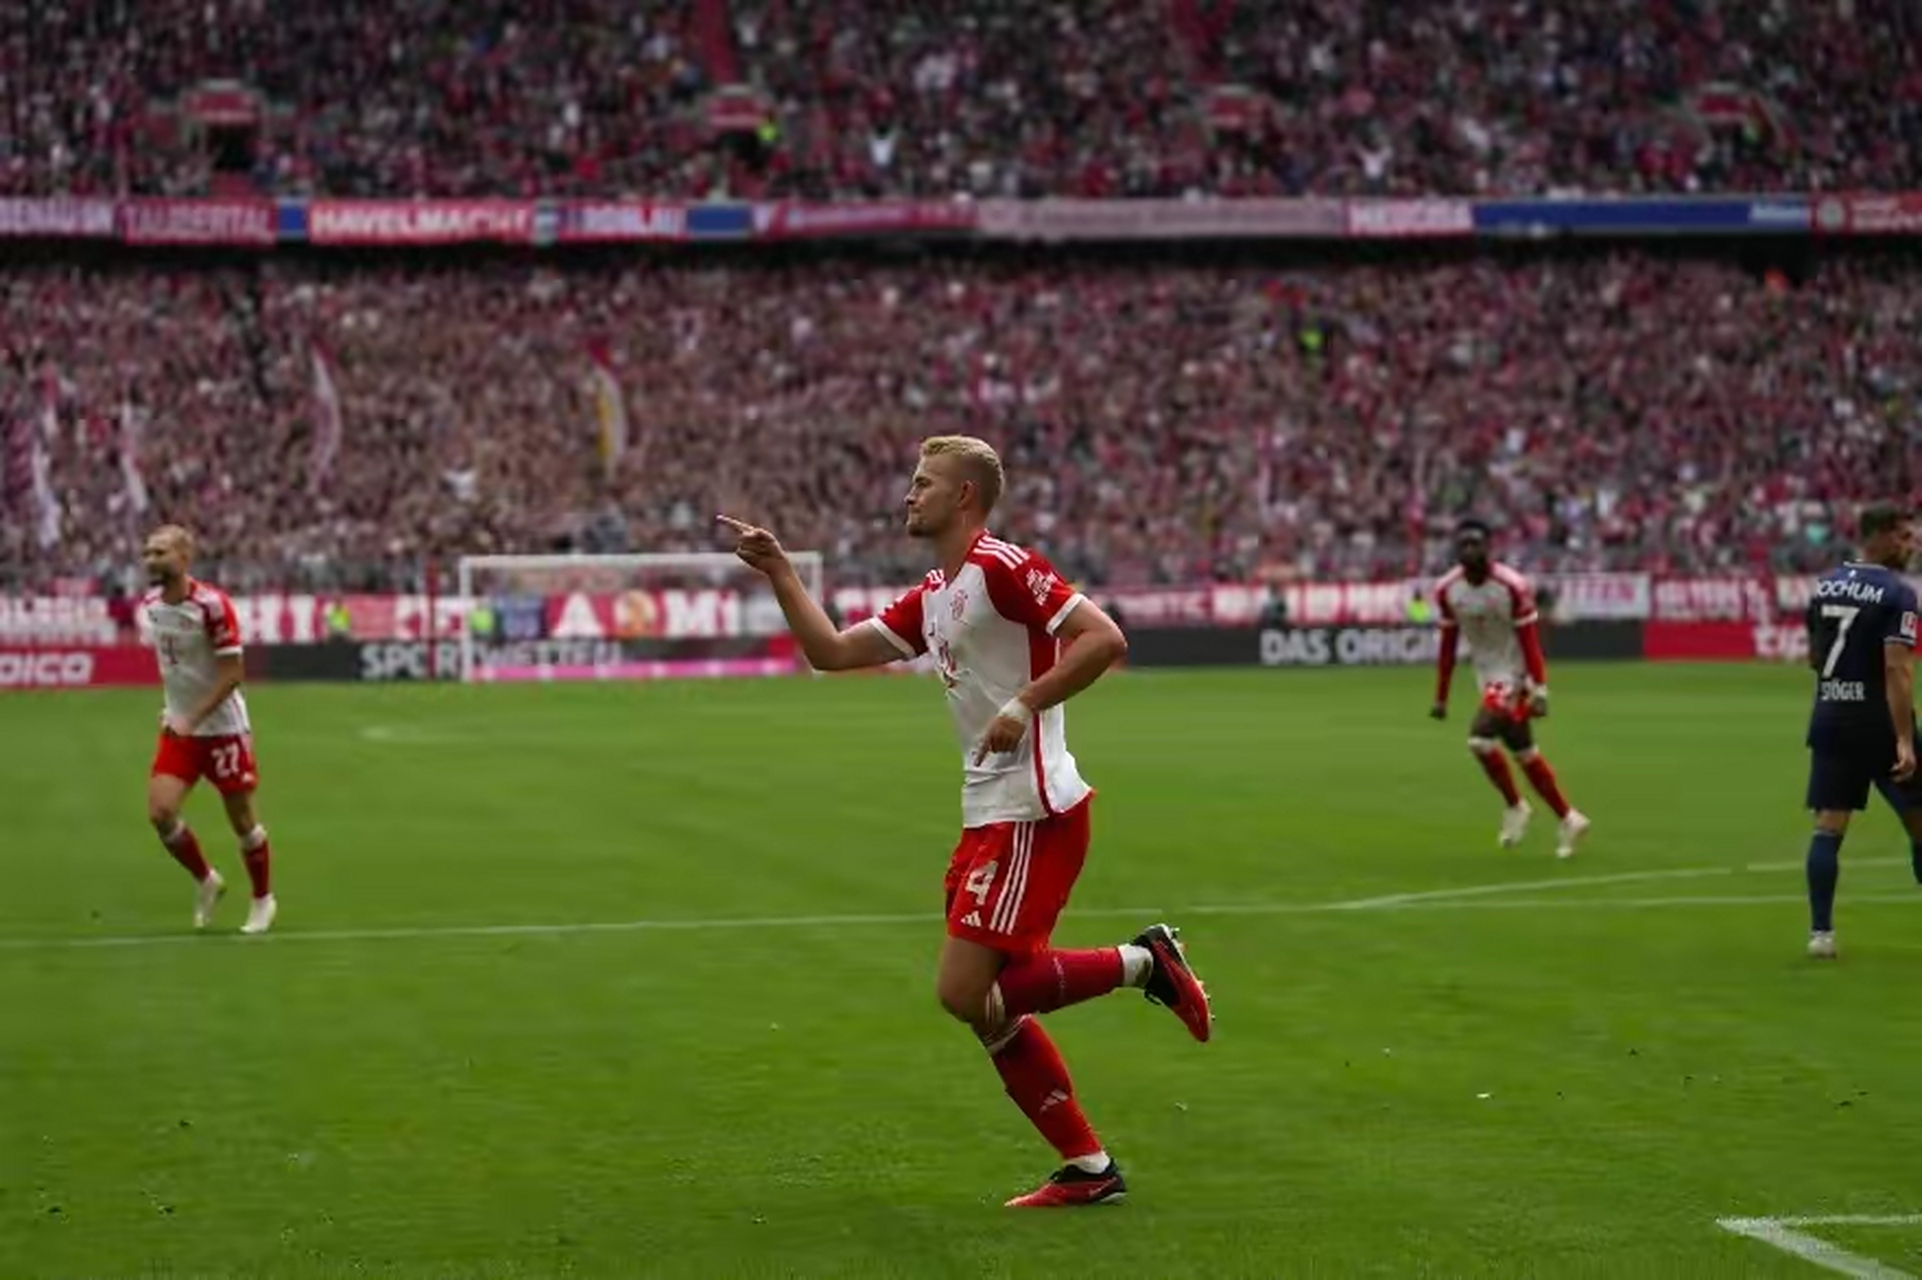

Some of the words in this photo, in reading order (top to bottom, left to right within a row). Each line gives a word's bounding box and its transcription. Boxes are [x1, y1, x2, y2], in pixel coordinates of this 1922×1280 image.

[1816, 579, 1885, 604] OCHUM
[1260, 628, 1329, 665] DAS
[1821, 604, 1860, 679] 7
[211, 742, 240, 778] 27
[964, 859, 999, 906] 4
